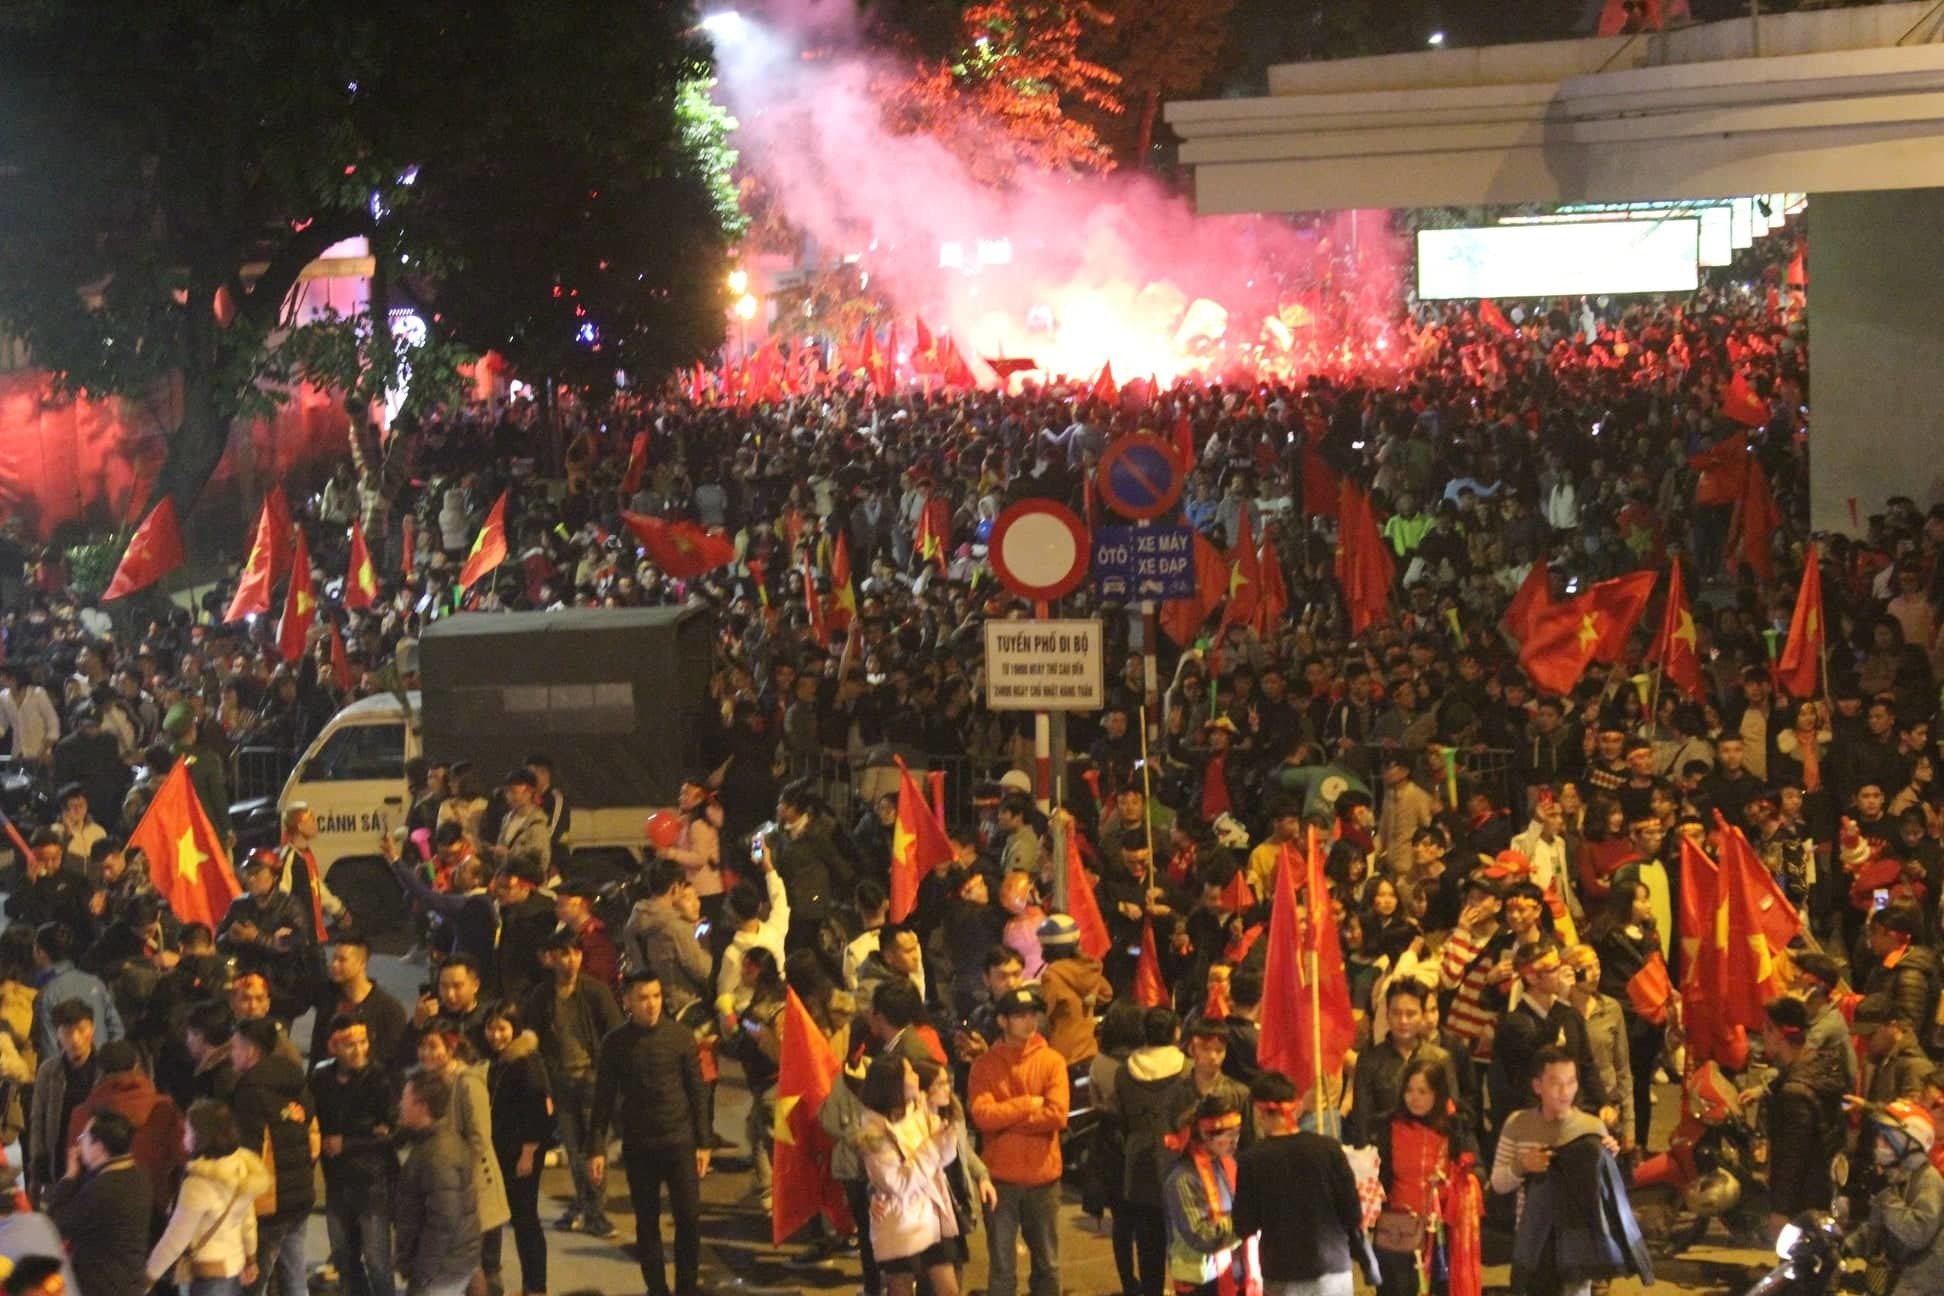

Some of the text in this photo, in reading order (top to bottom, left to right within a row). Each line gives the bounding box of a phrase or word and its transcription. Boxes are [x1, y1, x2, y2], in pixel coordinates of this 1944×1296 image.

[1137, 532, 1187, 551] XE MÁY
[1137, 558, 1155, 574] XE
[997, 632, 1088, 656] TUYẾN PHỐ ĐI BỘ
[317, 808, 386, 833] CẢNH SÁ
